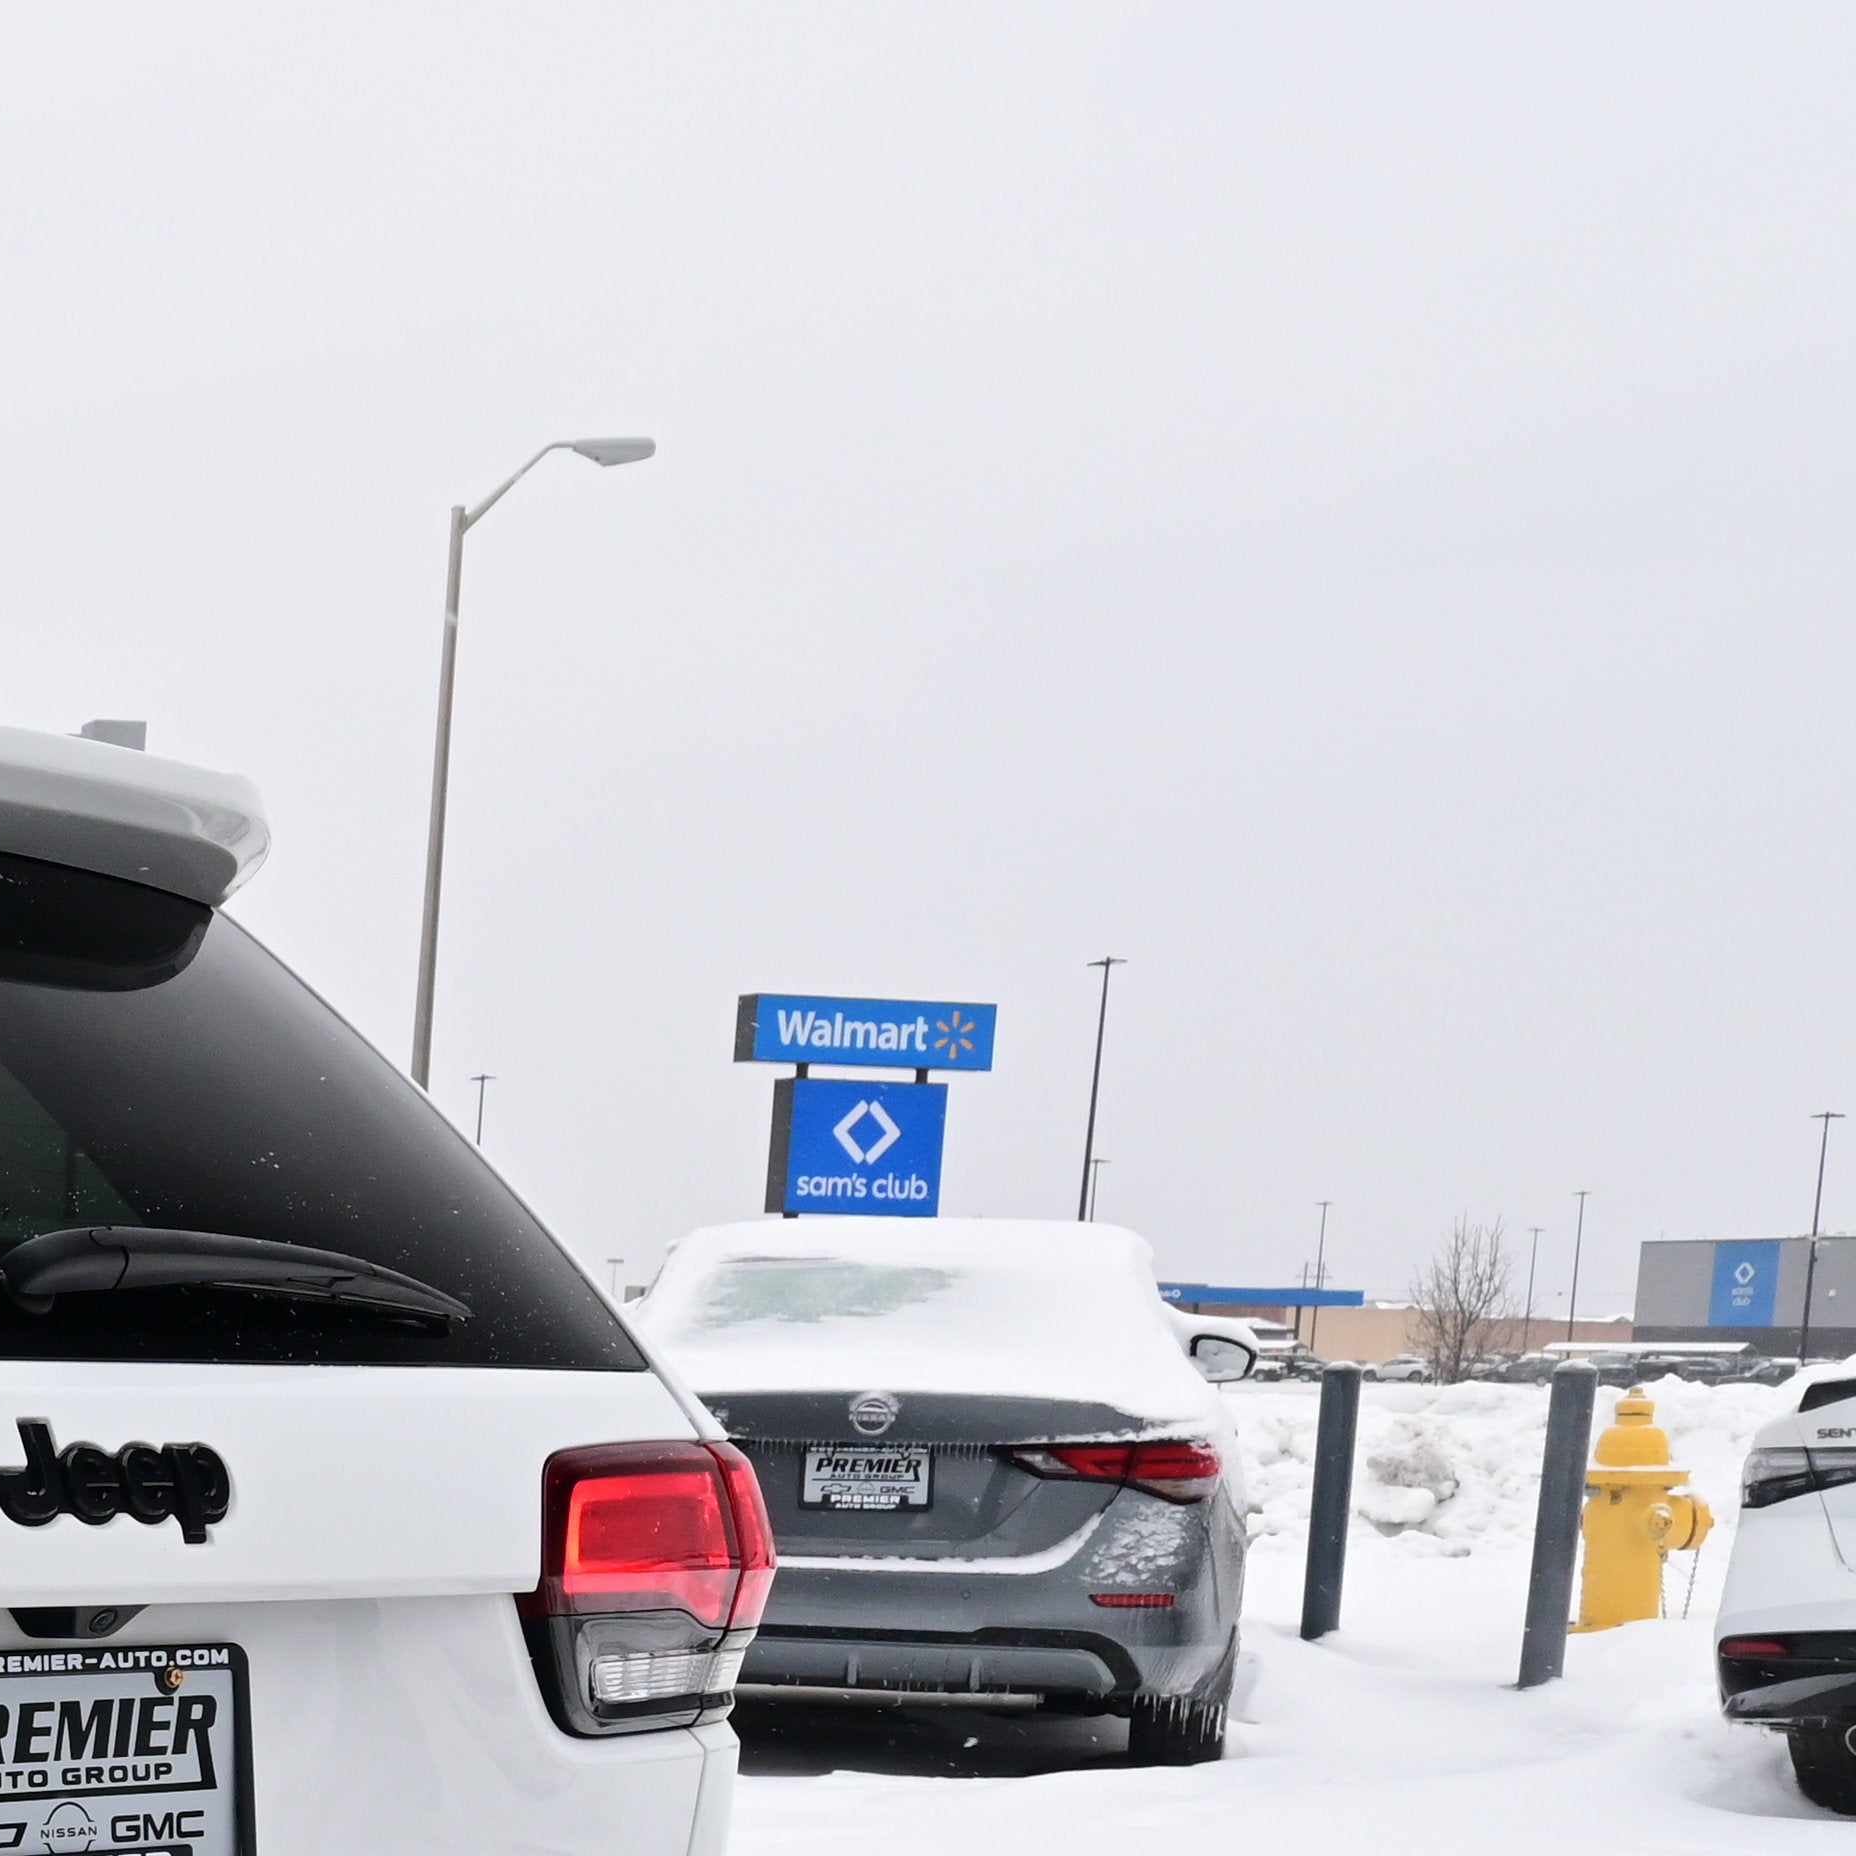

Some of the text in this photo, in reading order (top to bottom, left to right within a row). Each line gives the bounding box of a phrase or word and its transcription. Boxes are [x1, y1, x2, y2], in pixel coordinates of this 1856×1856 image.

[777, 1009, 929, 1051] Walmart
[796, 1172, 929, 1200] sam's club
[815, 1458, 922, 1473] PREMIER
[830, 1494, 901, 1504] PREMIER
[61, 1762, 174, 1787] GROUP
[40, 1810, 205, 1843] NISSAN GMC
